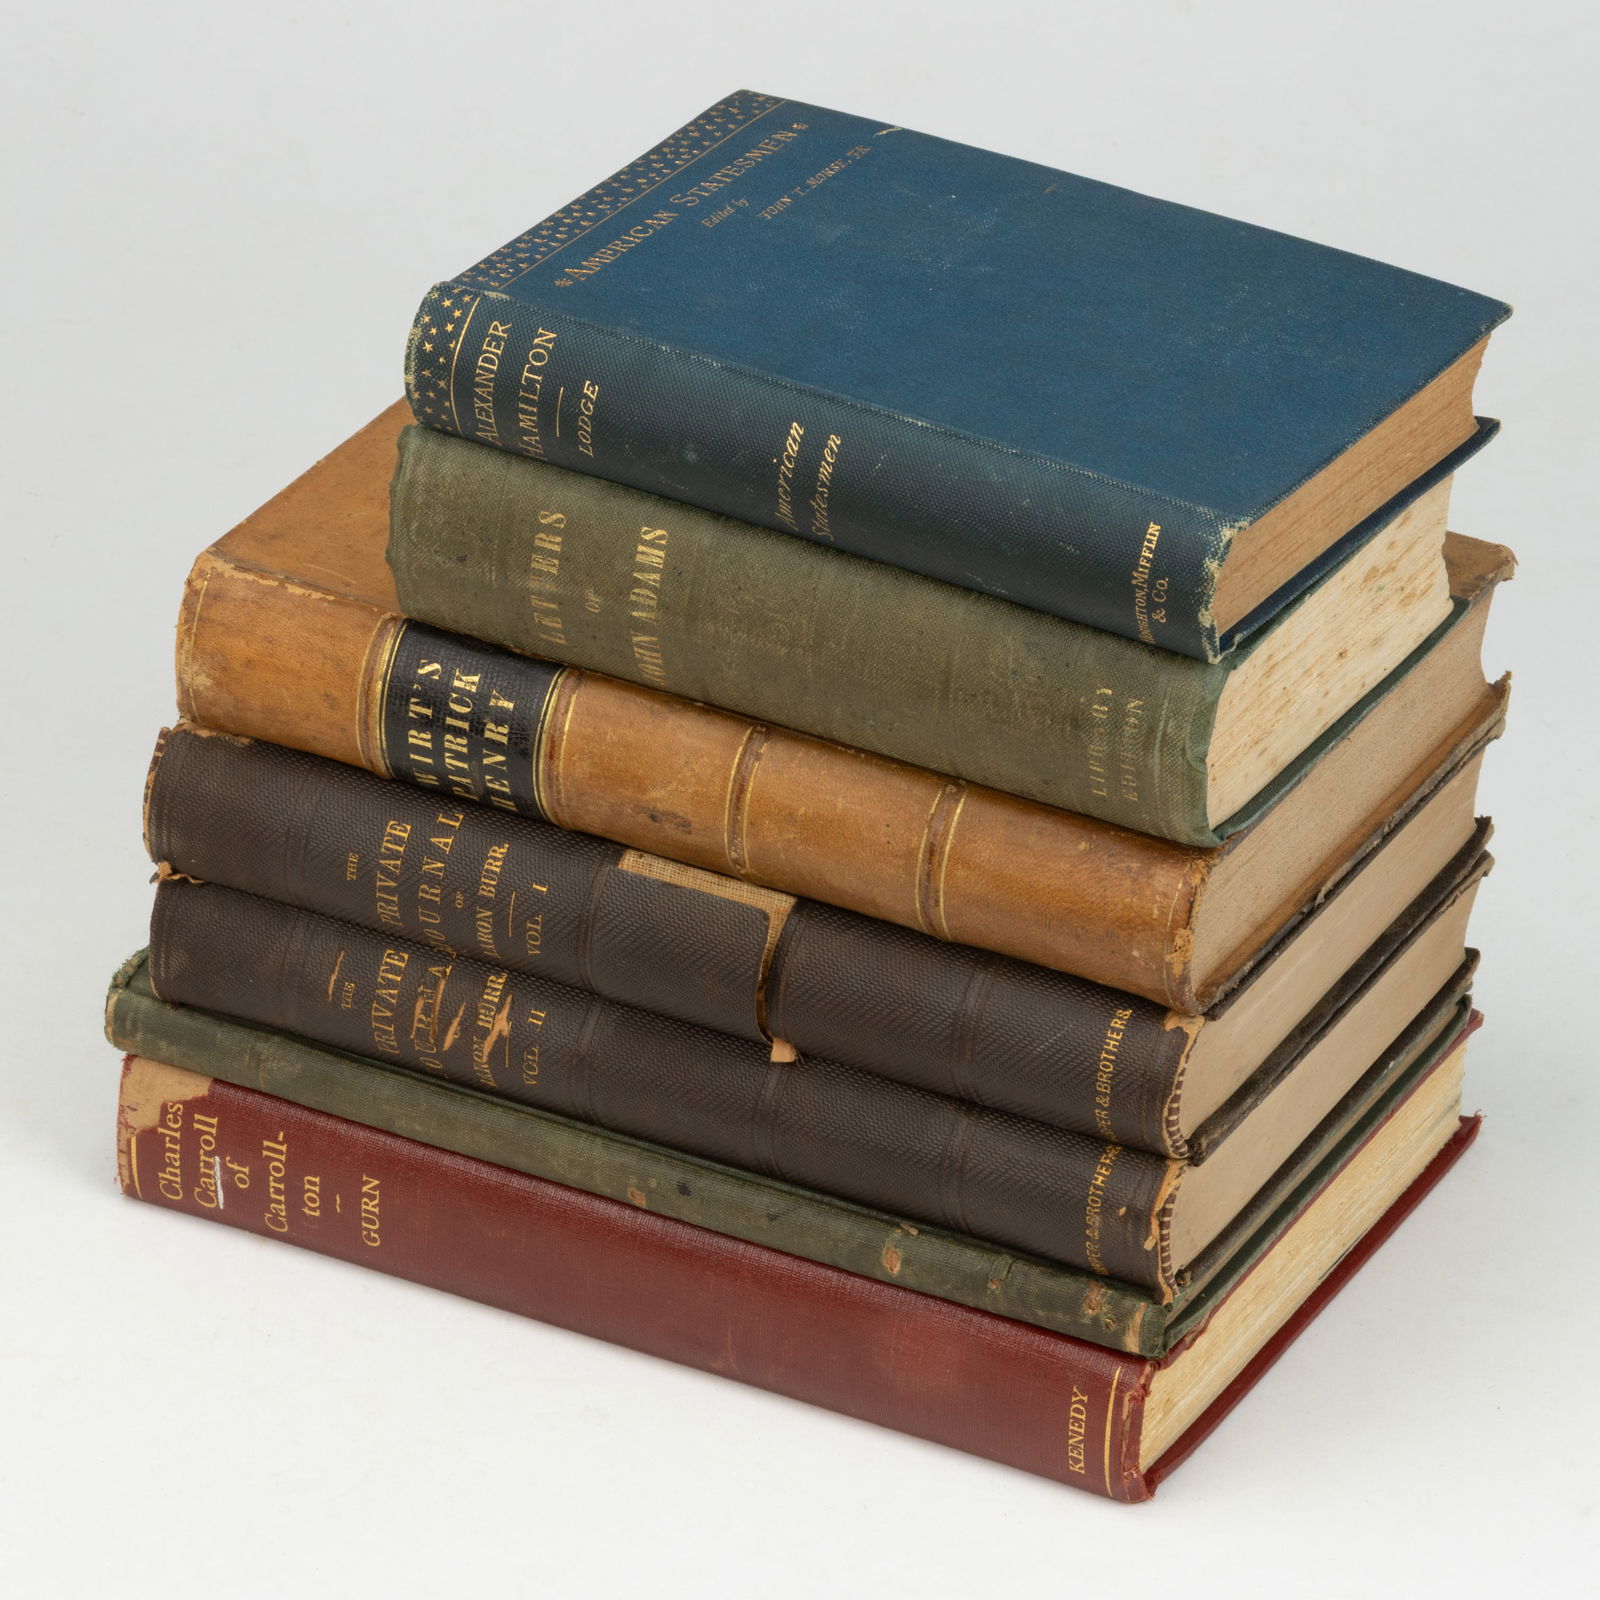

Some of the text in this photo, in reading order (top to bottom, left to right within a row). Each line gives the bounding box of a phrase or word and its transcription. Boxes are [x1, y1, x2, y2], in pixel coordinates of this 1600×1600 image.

[563, 129, 798, 281] AMERICAN STATESMEN
[701, 202, 736, 229] Edited
[757, 195, 793, 220] JOHN
[474, 320, 513, 447] ALEXANDER
[519, 327, 558, 461] HAMILTON
[578, 380, 599, 458] LODGE
[773, 421, 805, 532] American
[810, 434, 842, 541] Statesmen
[527, 511, 567, 645] LETTERS
[629, 526, 669, 625] ADAMS
[1151, 607, 1167, 624] &
[407, 659, 442, 786] WIRT'S
[443, 668, 481, 801] PATRICK
[482, 689, 519, 812] HENRY
[346, 852, 360, 881] THE
[375, 820, 412, 927] PRIVATE
[454, 891, 465, 909] OF
[478, 843, 510, 900] BURR.
[532, 882, 549, 895] I
[371, 949, 410, 1055] PRIVATE
[527, 1008, 547, 1028] II
[1096, 1089, 1111, 1108] &
[157, 1101, 183, 1200] Charles
[193, 1114, 218, 1208] Carroll
[226, 1156, 250, 1189] of
[262, 1131, 288, 1233] Carroll-
[301, 1175, 321, 1217] ton
[361, 1174, 382, 1247] GURN
[1068, 1385, 1089, 1475] KENEDY
